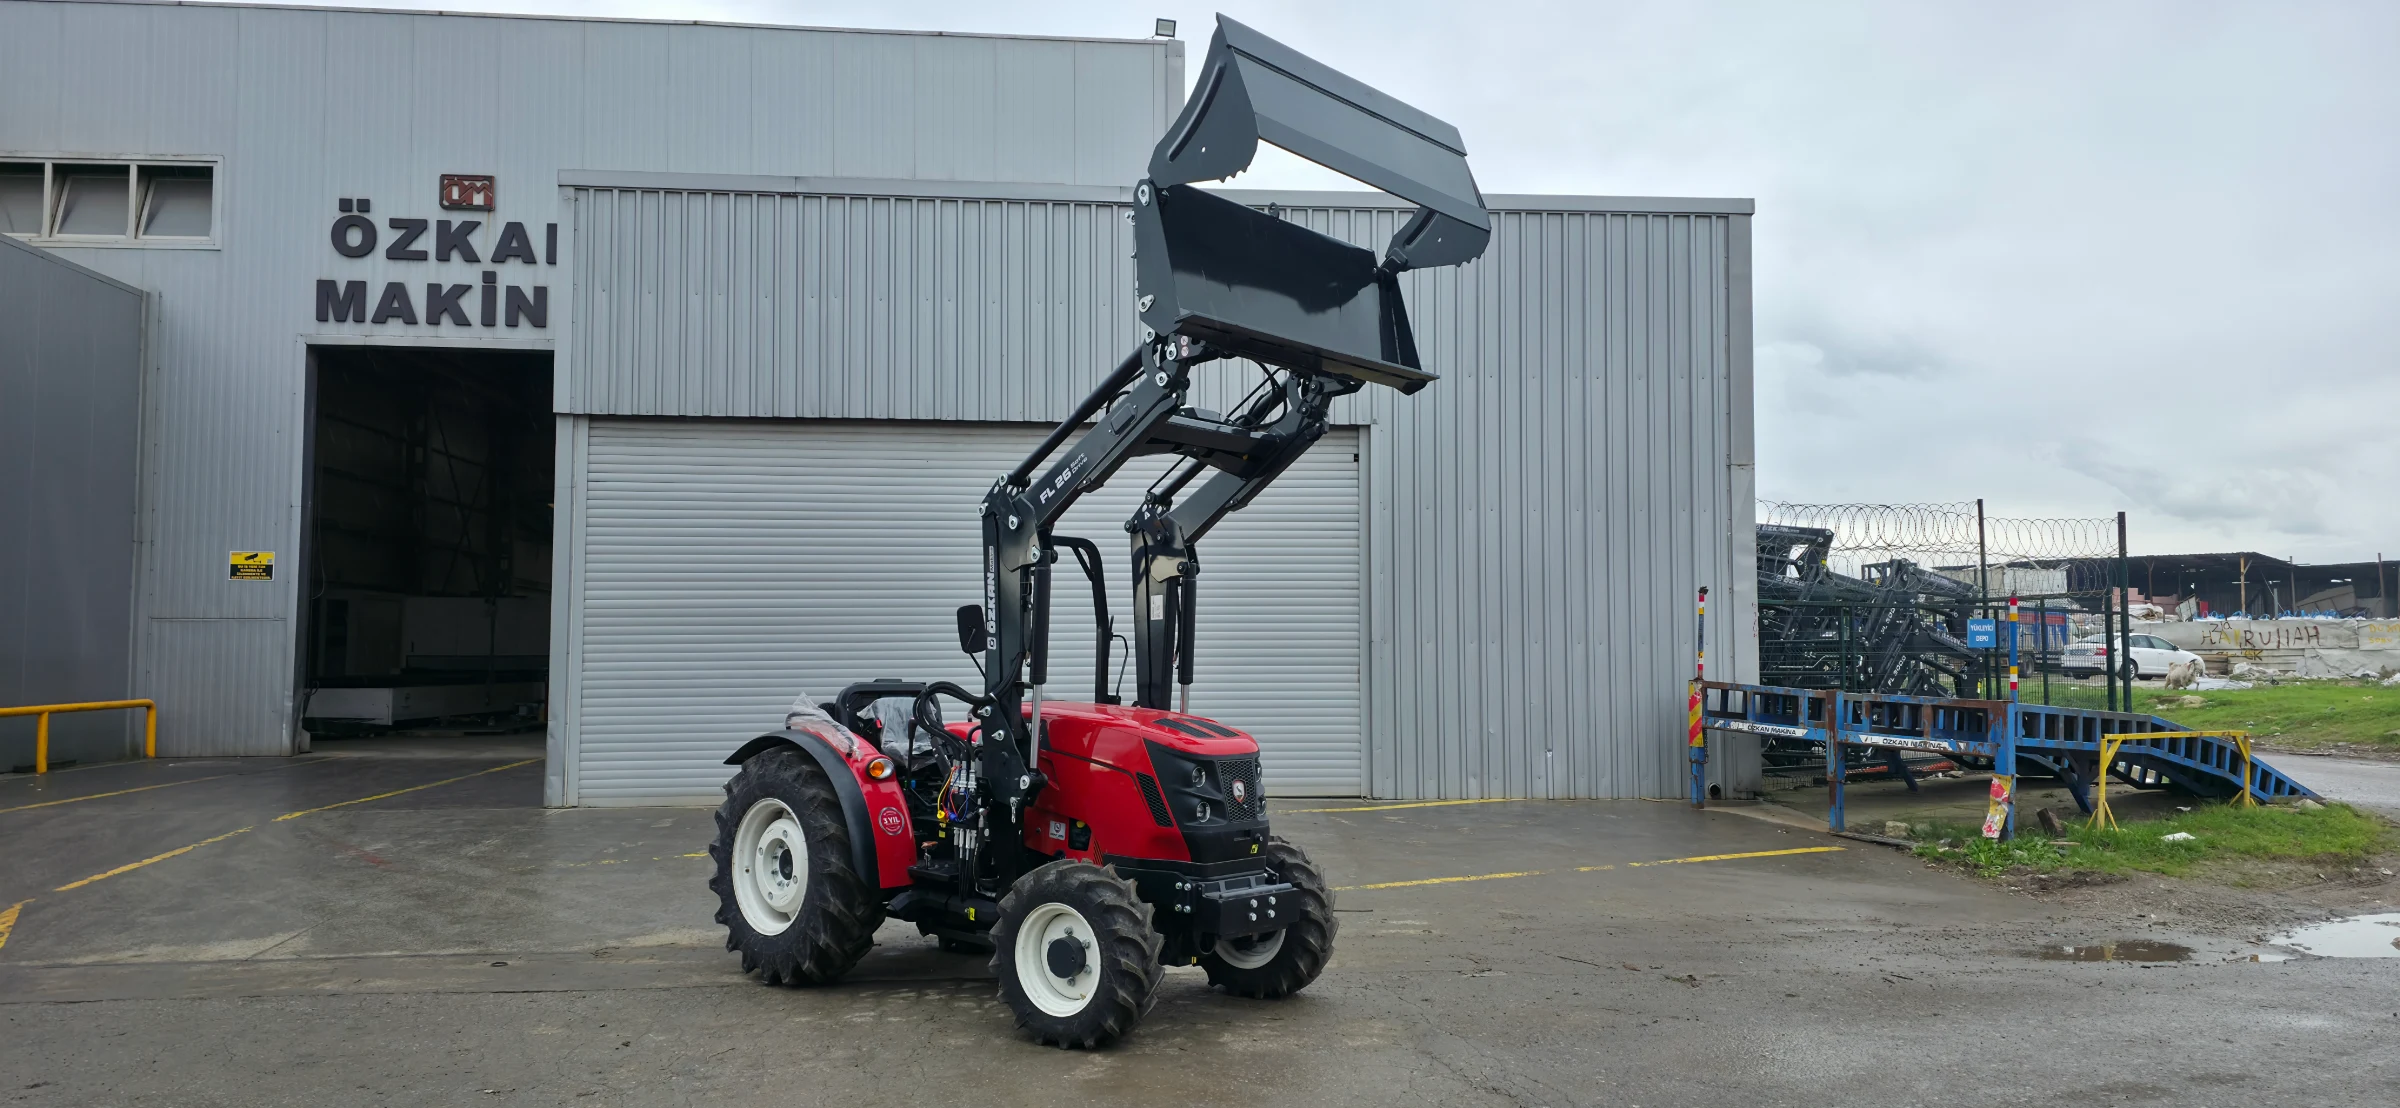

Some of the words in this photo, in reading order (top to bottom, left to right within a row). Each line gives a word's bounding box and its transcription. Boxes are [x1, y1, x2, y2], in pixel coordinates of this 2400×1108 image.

[331, 198, 557, 265] ÖZKA
[1040, 487, 1056, 504] FL
[1055, 467, 1072, 489] 26
